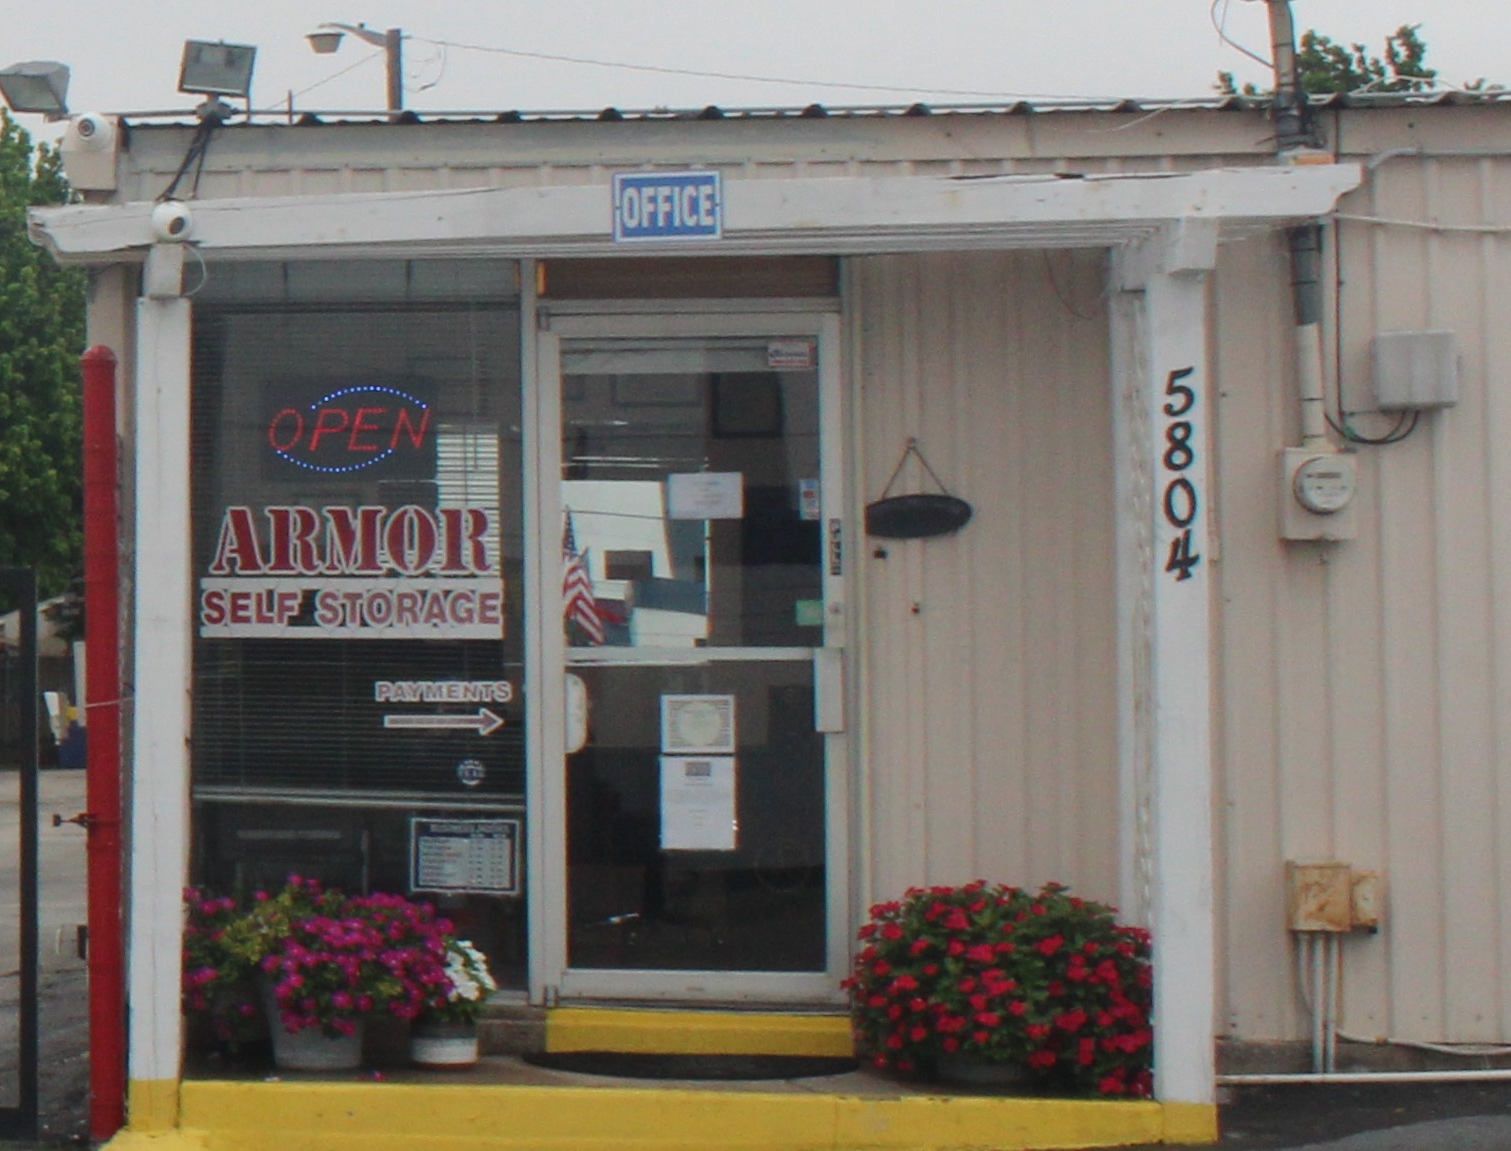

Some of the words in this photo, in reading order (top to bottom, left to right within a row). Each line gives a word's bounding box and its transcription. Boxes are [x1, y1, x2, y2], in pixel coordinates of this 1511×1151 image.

[622, 185, 715, 229] OFFICE
[268, 408, 431, 452] OPEN
[1163, 366, 1200, 582] 5804
[209, 506, 492, 576] ARMOR
[203, 590, 302, 627] SELF
[314, 590, 501, 628] STORAGE
[375, 681, 512, 702] PAYMENTS
